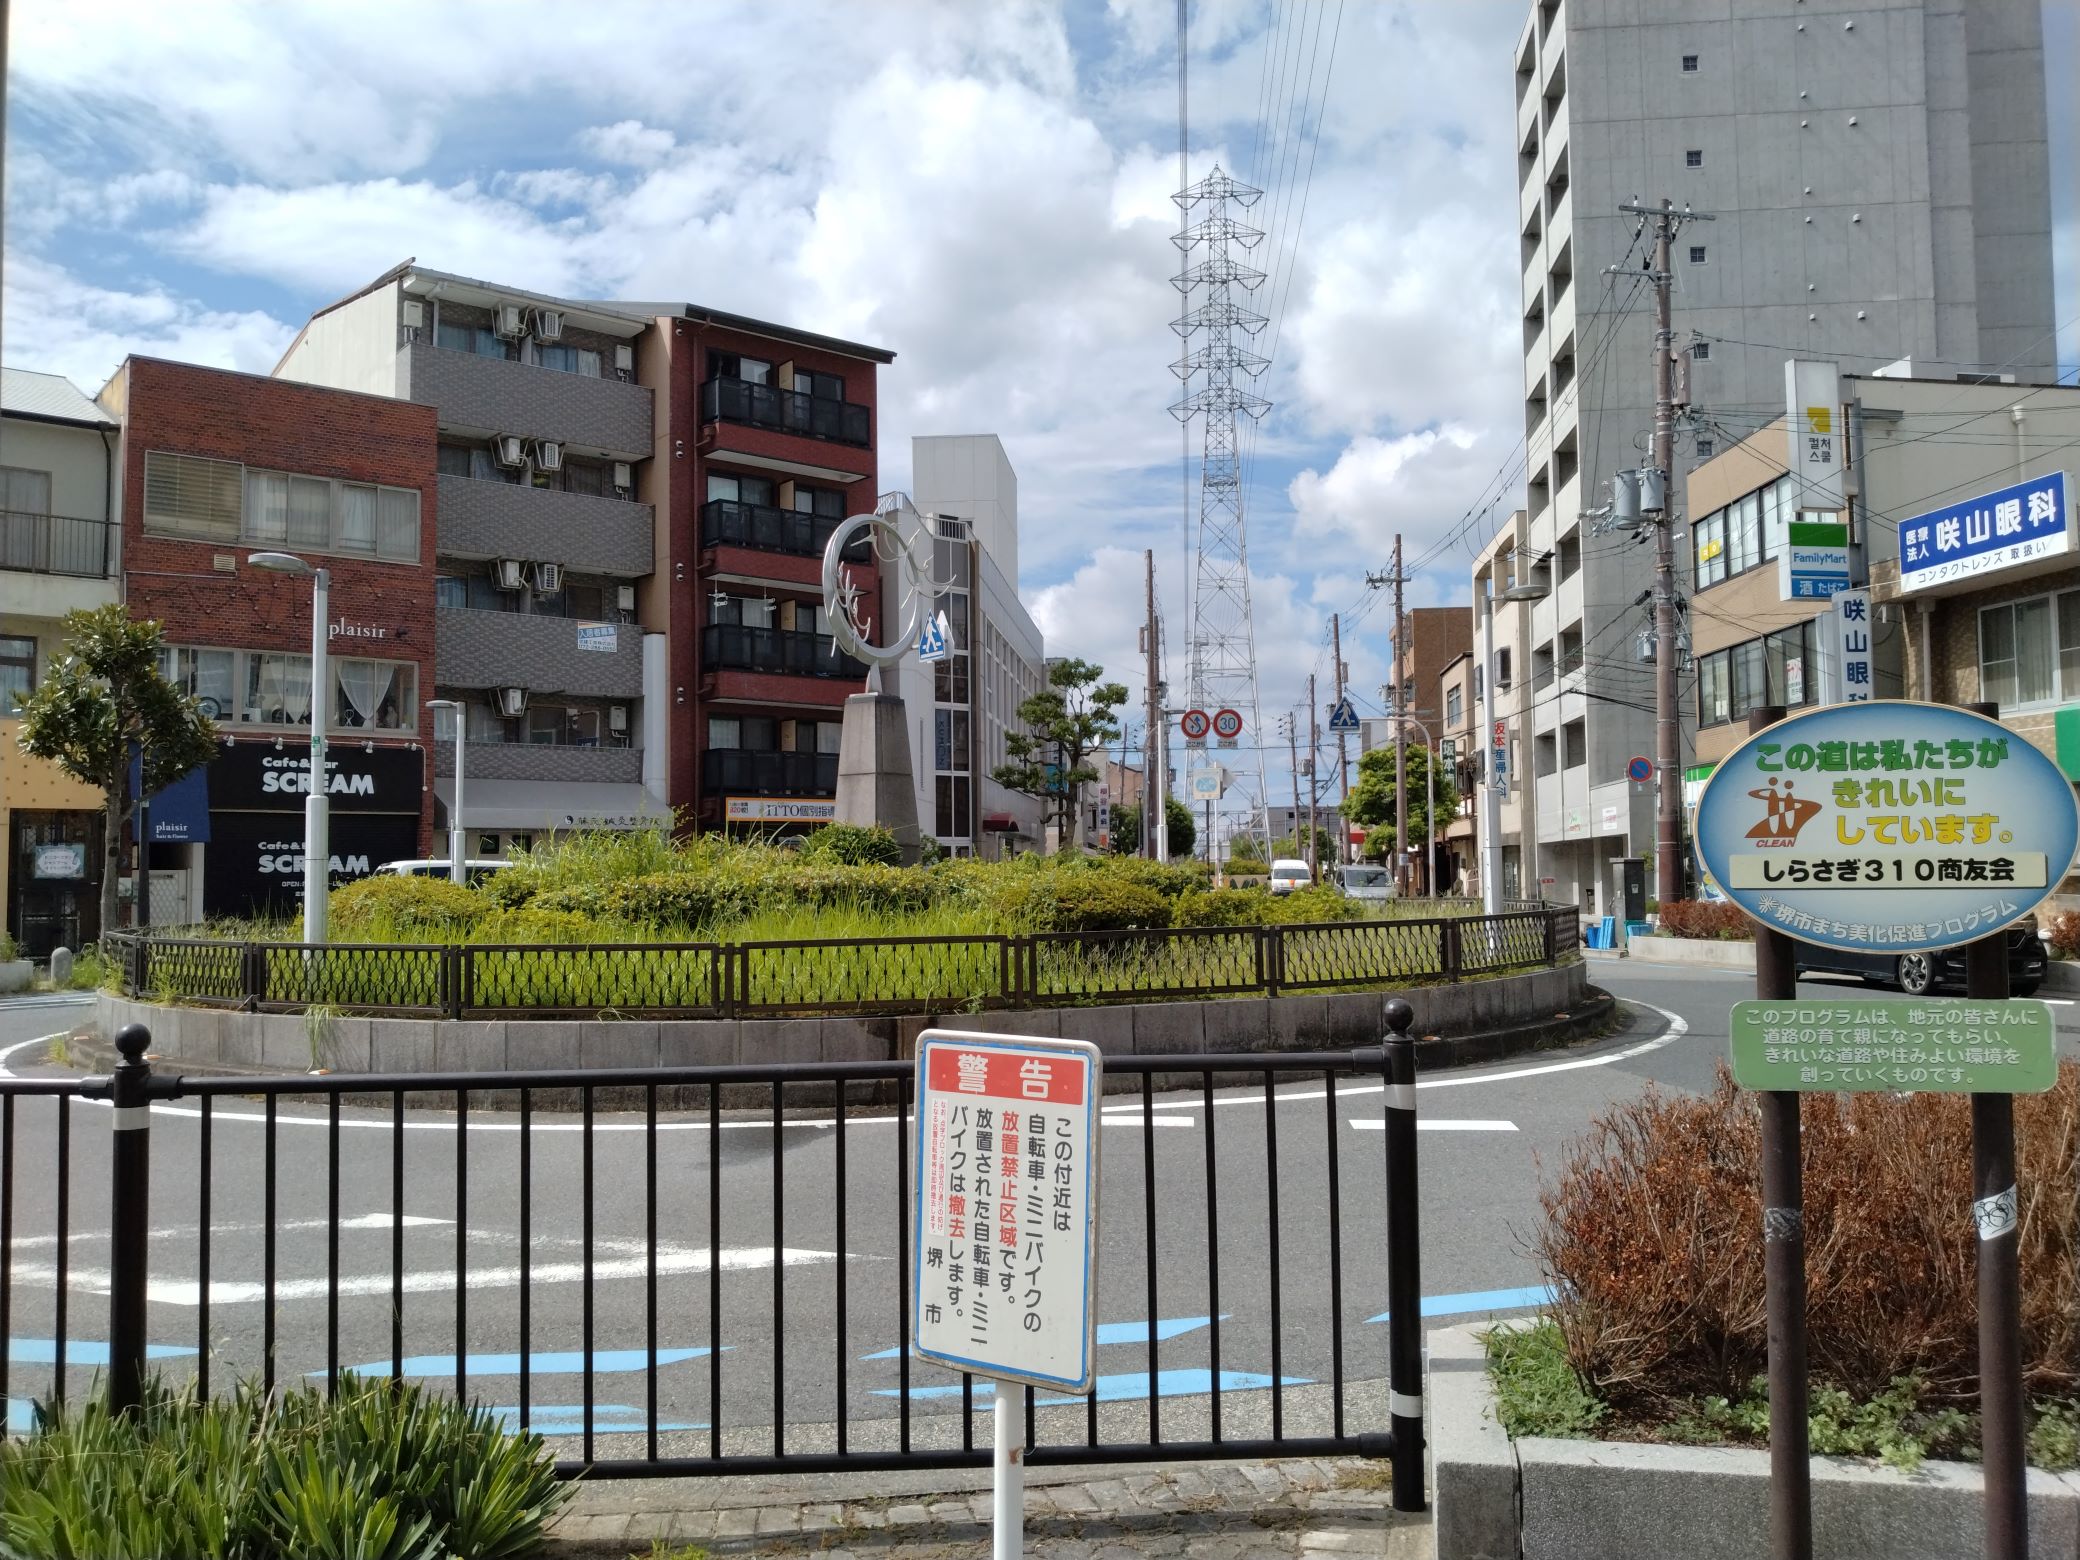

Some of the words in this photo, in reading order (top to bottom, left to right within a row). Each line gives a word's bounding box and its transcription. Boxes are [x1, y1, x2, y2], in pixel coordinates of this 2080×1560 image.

[1808, 437, 1831, 450] 컬처
[1935, 488, 2057, 553] 咲山眼科
[1905, 526, 1929, 546] 医療
[1793, 552, 1847, 566] FamilyMart
[1906, 544, 1930, 562] 法人
[1917, 551, 2004, 584] コンタクトレンズ
[2010, 541, 2047, 560] 取扱い
[1799, 580, 1813, 596] 酒
[328, 617, 386, 640] plaisir
[1219, 717, 1236, 730] 30
[262, 757, 339, 769] Cafe&ar
[1754, 737, 2010, 773] この道は私たちが
[1831, 777, 1967, 809] きれいに
[156, 821, 188, 833] plaisir
[1835, 813, 2013, 846] しています。
[258, 841, 305, 850] Cafe&
[1755, 838, 1796, 848] CLEAN
[258, 854, 370, 876] SCRAM
[1763, 857, 2015, 883] しらさぎ310商友会
[1774, 897, 2018, 944] 堺市まち美化促進プログラム
[1745, 1008, 2039, 1026] このプログラムは、地元の皆さんに
[1762, 1028, 2011, 1045] 道路の育て親になってもらい、
[1764, 1047, 2021, 1065] きれいな道路や住みよい環境を
[957, 1053, 1053, 1099] 警告
[1799, 1066, 1976, 1084] 創っていくものです。
[1053, 1117, 1073, 1232] この付近は
[946, 1105, 969, 1319] バイクは撤去します。
[998, 1110, 1020, 1306] 放置禁止区域です。
[971, 1107, 994, 1345] 放置された自転車・ミニ
[1023, 1113, 1046, 1334] 自転車・ミニバイクの
[925, 1246, 944, 1325] 堺市
